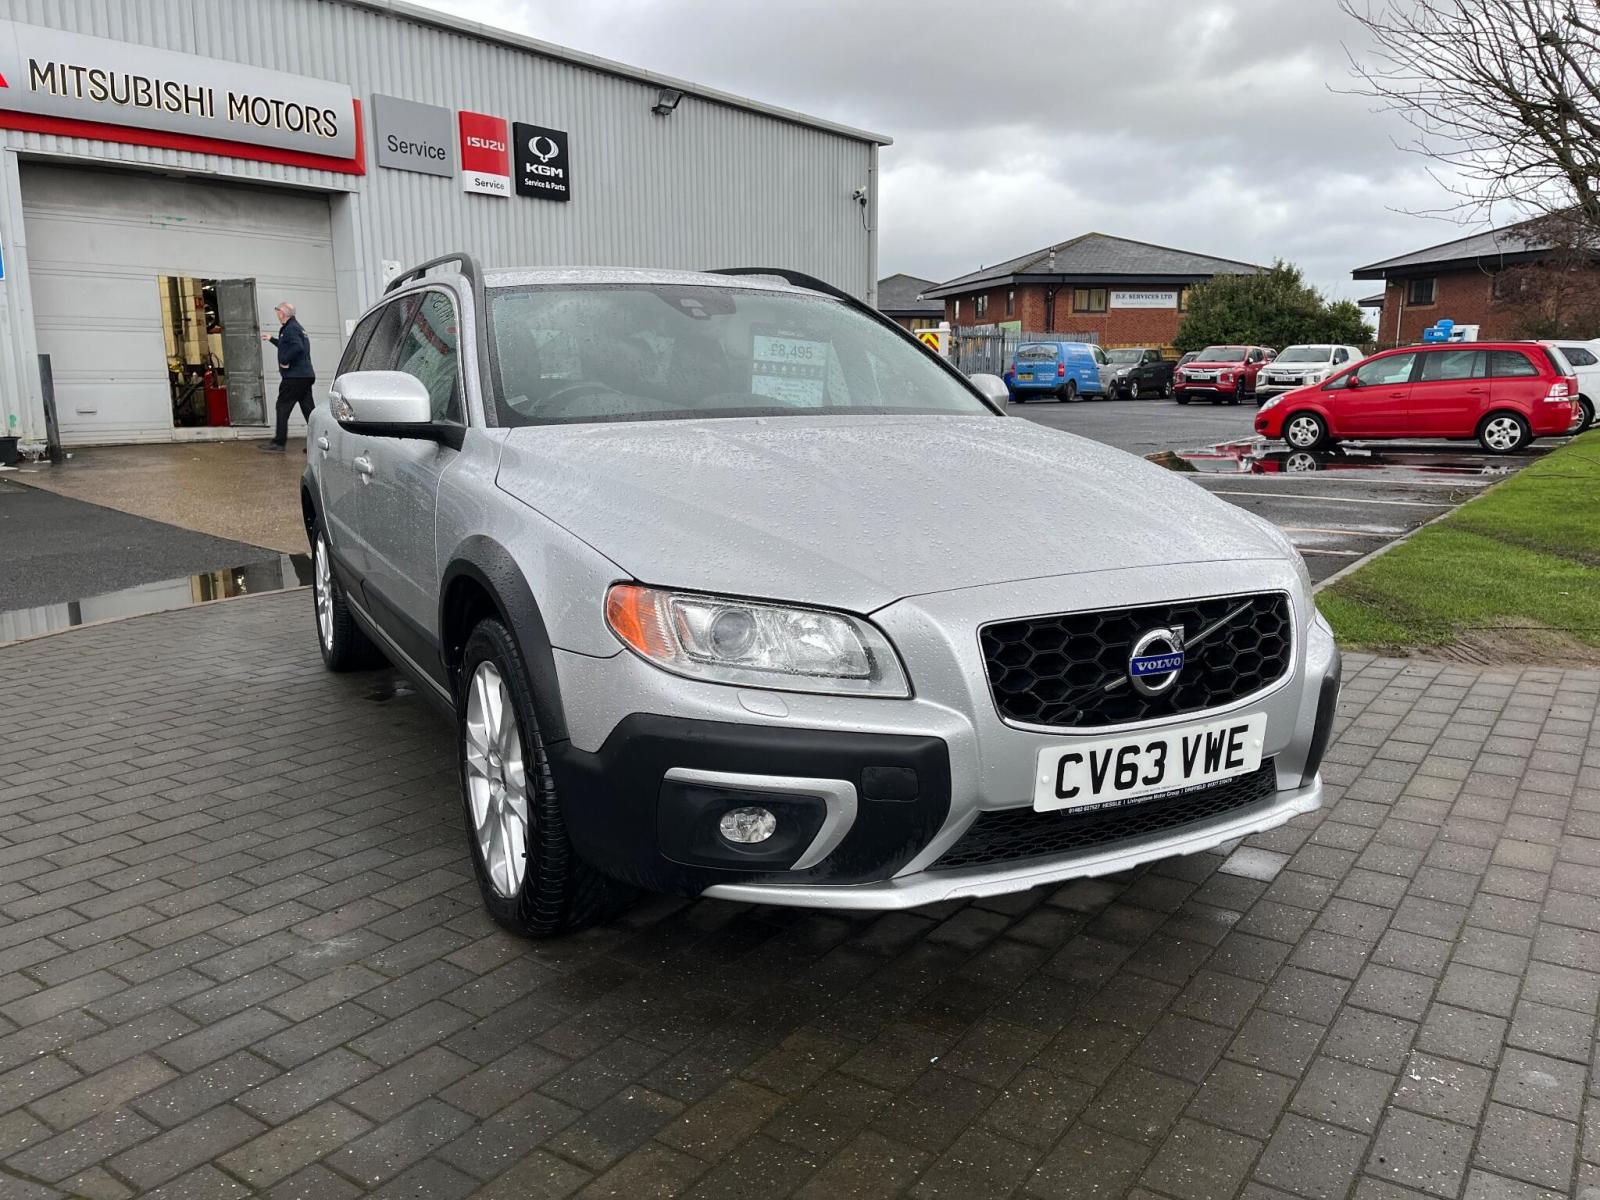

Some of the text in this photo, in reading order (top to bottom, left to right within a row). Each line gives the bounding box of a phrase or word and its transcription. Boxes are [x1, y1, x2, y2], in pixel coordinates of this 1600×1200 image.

[28, 57, 339, 139] MITSUBISHI MOTORS
[387, 134, 447, 161] Service
[466, 136, 506, 152] ISUZU
[525, 162, 564, 179] KGM
[474, 177, 505, 190] Service
[524, 177, 546, 189] Service
[551, 182, 566, 192] Parts
[1135, 657, 1182, 672] VOLVO
[1055, 724, 1249, 800] CV63 VWE
